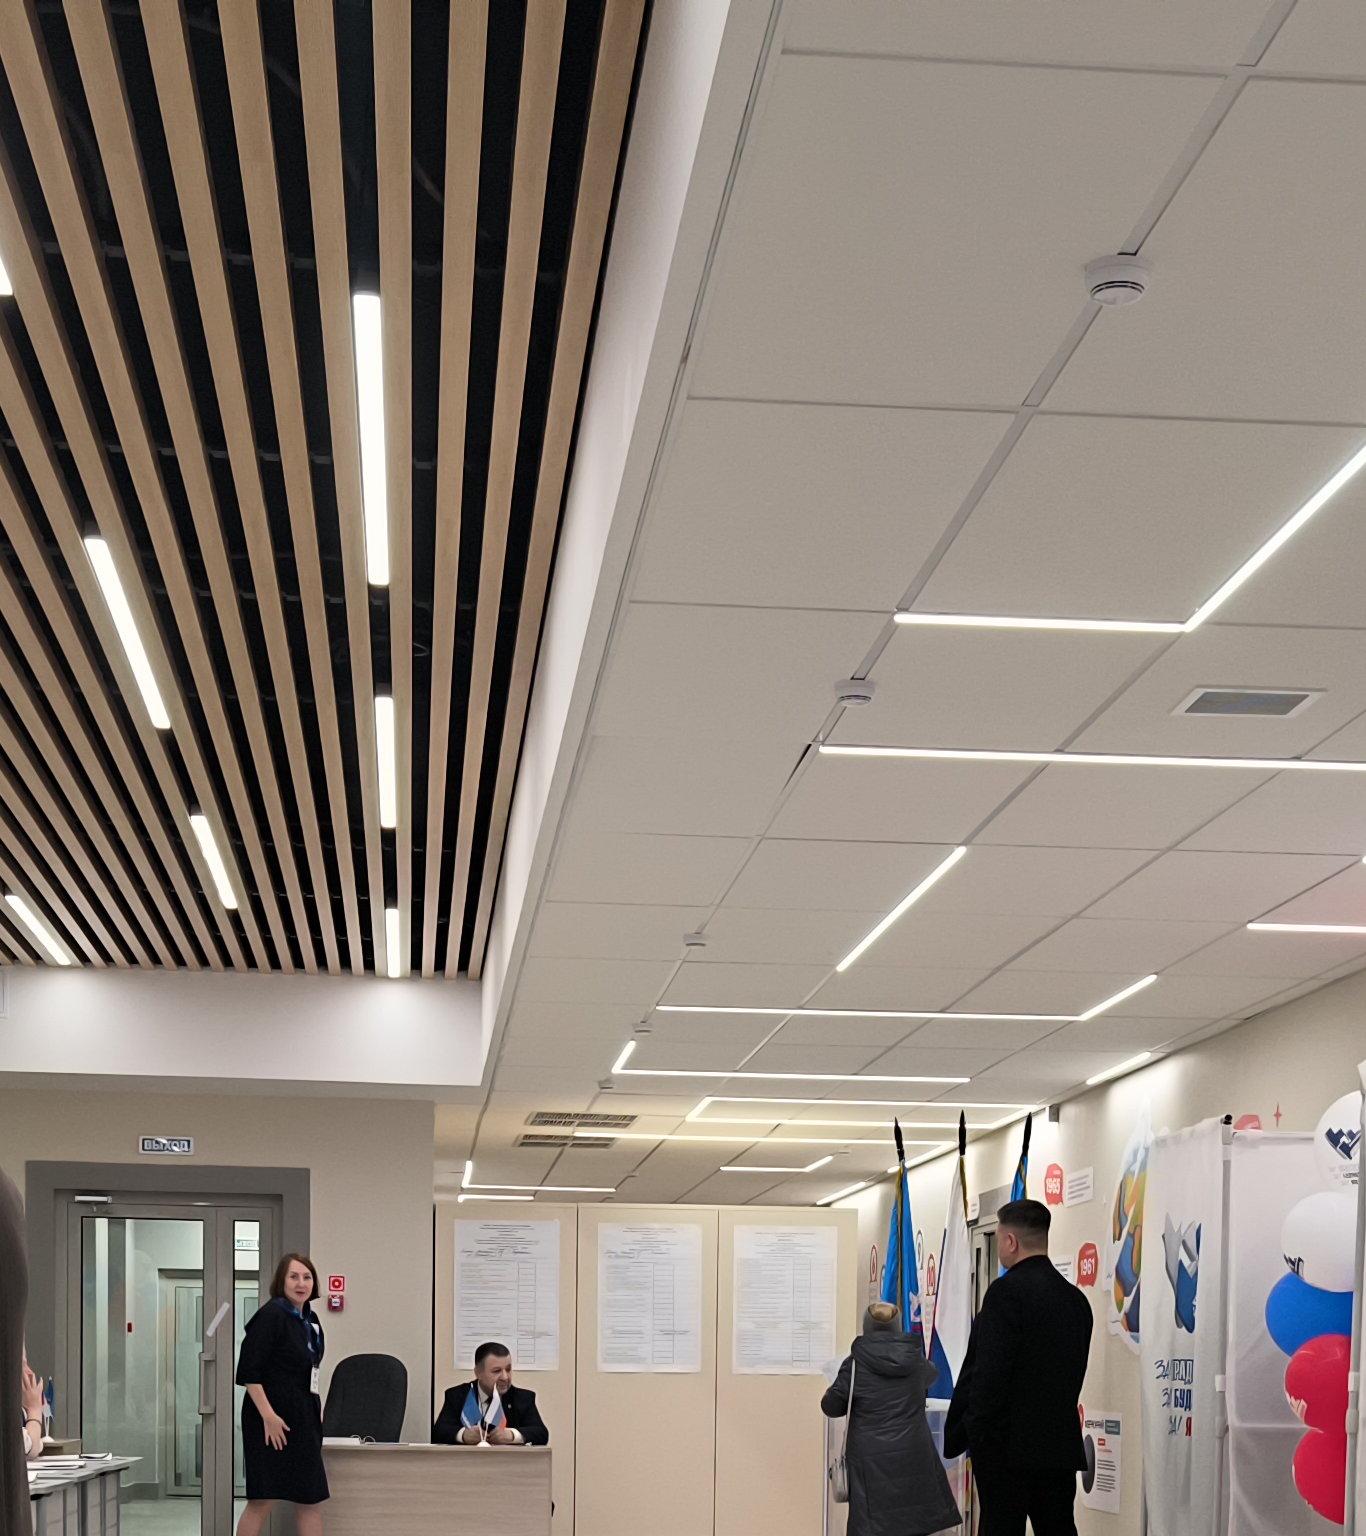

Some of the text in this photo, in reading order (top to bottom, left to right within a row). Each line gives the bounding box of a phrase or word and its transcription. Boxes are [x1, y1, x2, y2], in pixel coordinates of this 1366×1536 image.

[143, 1139, 189, 1152] ВЫХОД
[1046, 1178, 1061, 1195] 1965
[1080, 1257, 1095, 1276] 1961
[1174, 1388, 1192, 1411] БУД
